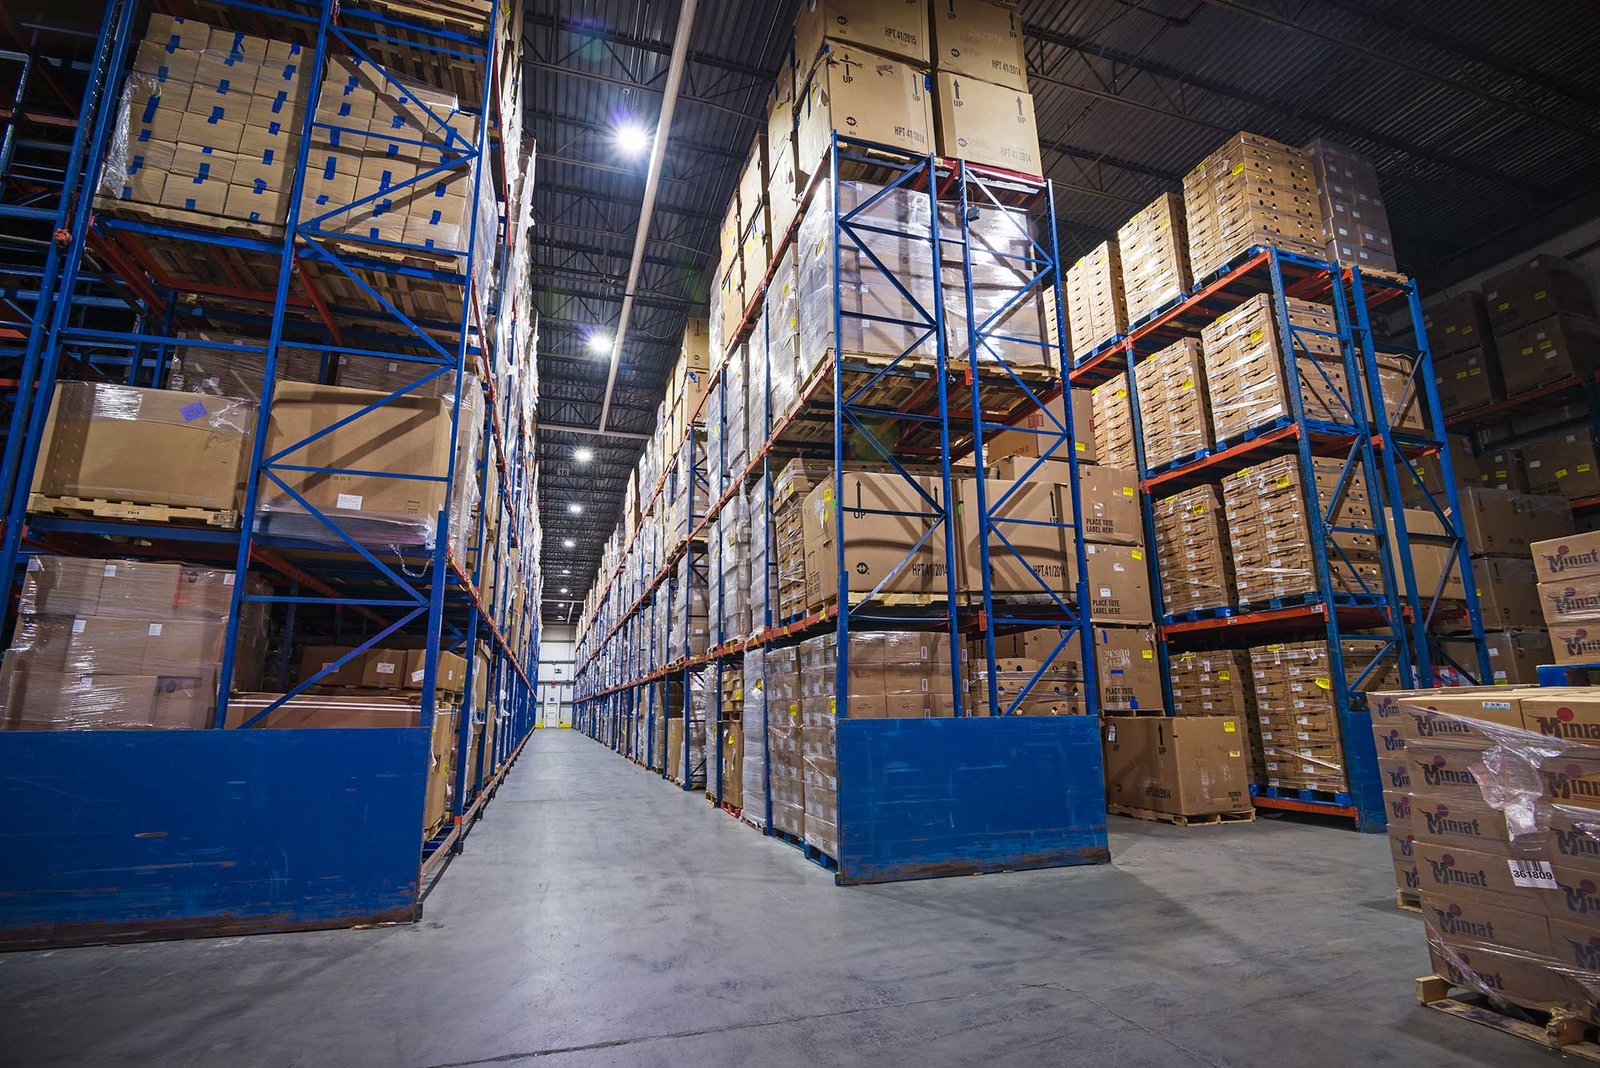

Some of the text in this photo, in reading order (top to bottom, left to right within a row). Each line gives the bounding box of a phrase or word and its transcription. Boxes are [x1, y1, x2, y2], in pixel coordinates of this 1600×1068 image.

[947, 12, 957, 20] UP
[1009, 31, 1017, 39] UP
[843, 75, 854, 84] UP
[912, 93, 921, 102] UP
[954, 100, 964, 108] UP
[1017, 115, 1026, 124] UP
[853, 510, 866, 519] UP
[1086, 518, 1114, 527] PLACE TOTE
[1086, 525, 1101, 533] LABEL
[1540, 548, 1599, 573] Miniat
[1093, 607, 1121, 615] LABEL HERE
[1105, 687, 1121, 695] PLACE
[1106, 695, 1121, 703] LABEL
[1408, 711, 1470, 737] Miniat
[1158, 746, 1167, 755] UP
[1417, 807, 1481, 835] Miniat
[1423, 855, 1488, 887] Miniat
[1513, 869, 1553, 880] 361809
[1429, 904, 1495, 939] Miniat
